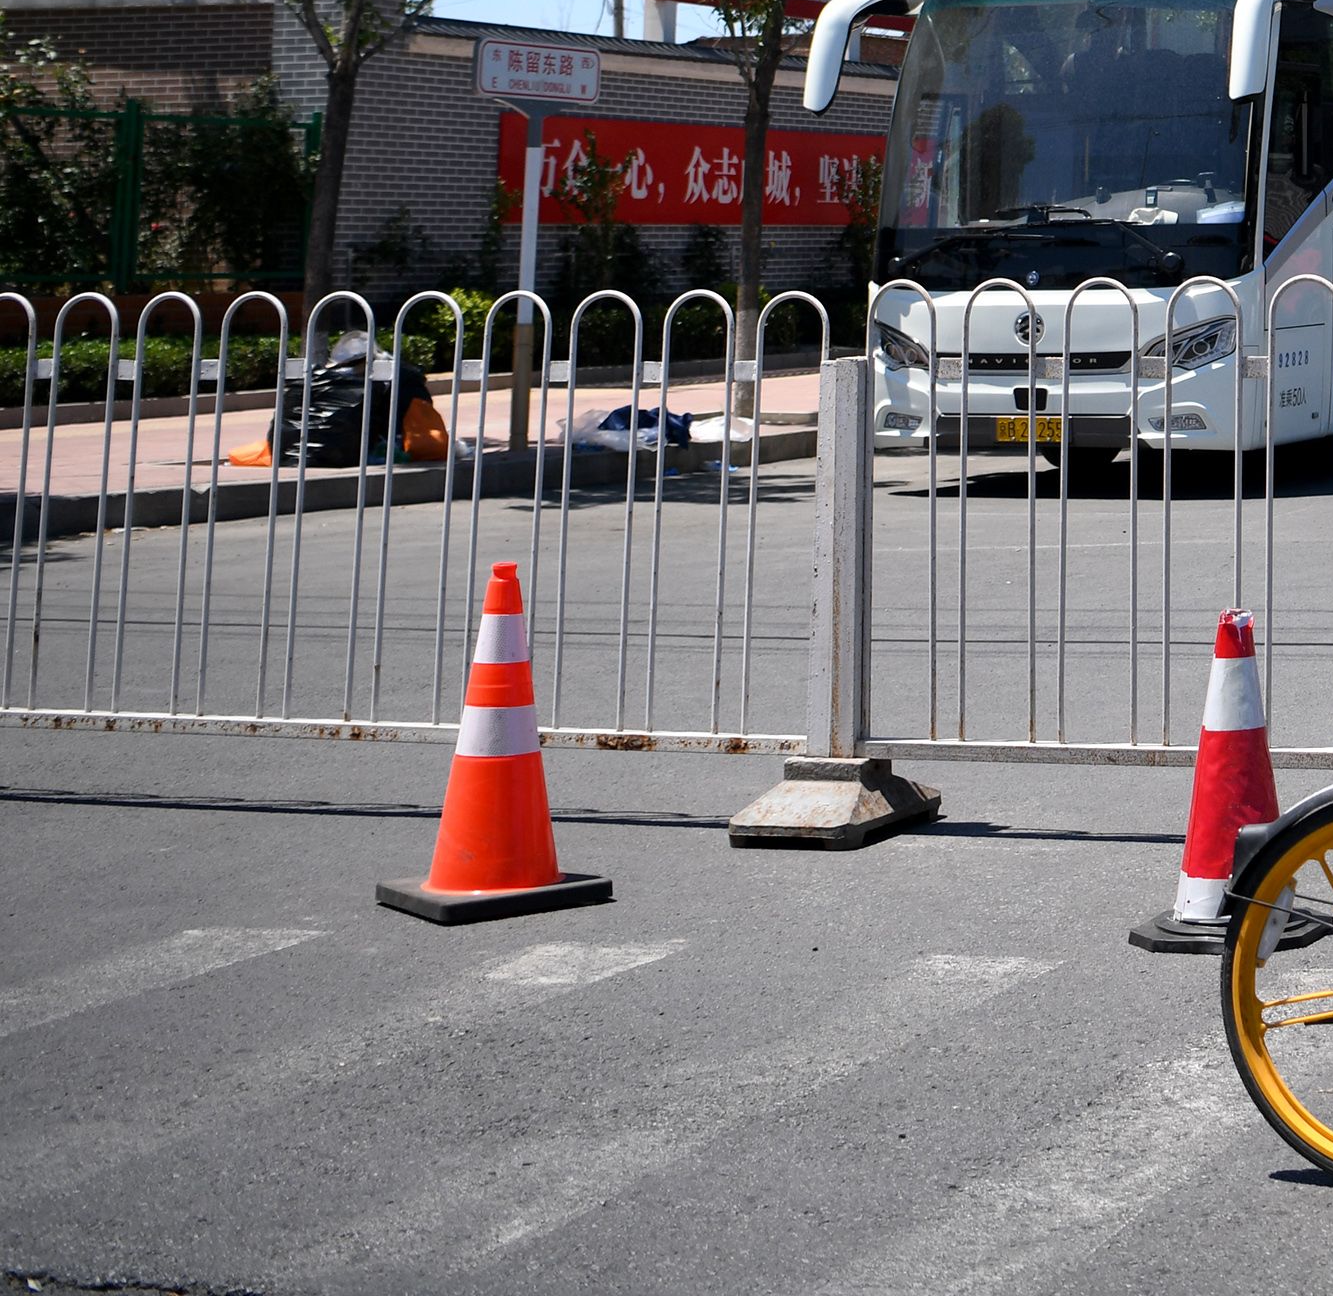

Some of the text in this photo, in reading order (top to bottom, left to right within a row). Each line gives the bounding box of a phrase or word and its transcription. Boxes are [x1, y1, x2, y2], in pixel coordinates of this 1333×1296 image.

[507, 49, 574, 76] 陈留东路
[1278, 350, 1309, 368] 92828
